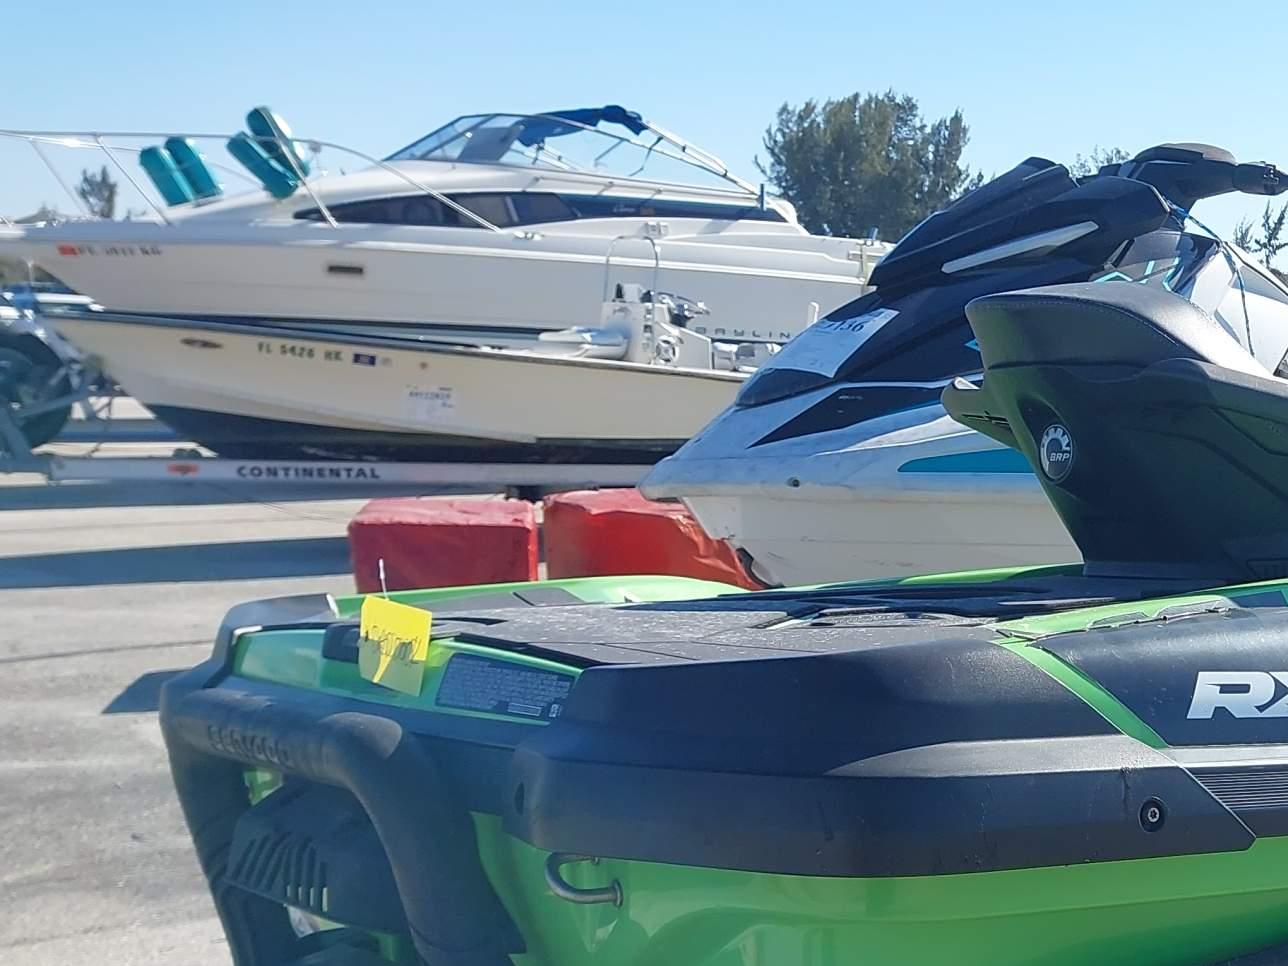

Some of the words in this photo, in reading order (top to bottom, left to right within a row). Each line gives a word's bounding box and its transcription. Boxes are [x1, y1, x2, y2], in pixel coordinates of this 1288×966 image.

[257, 342, 272, 354] FL
[1049, 452, 1070, 462] BRP
[236, 465, 380, 479] CONTINENTAL
